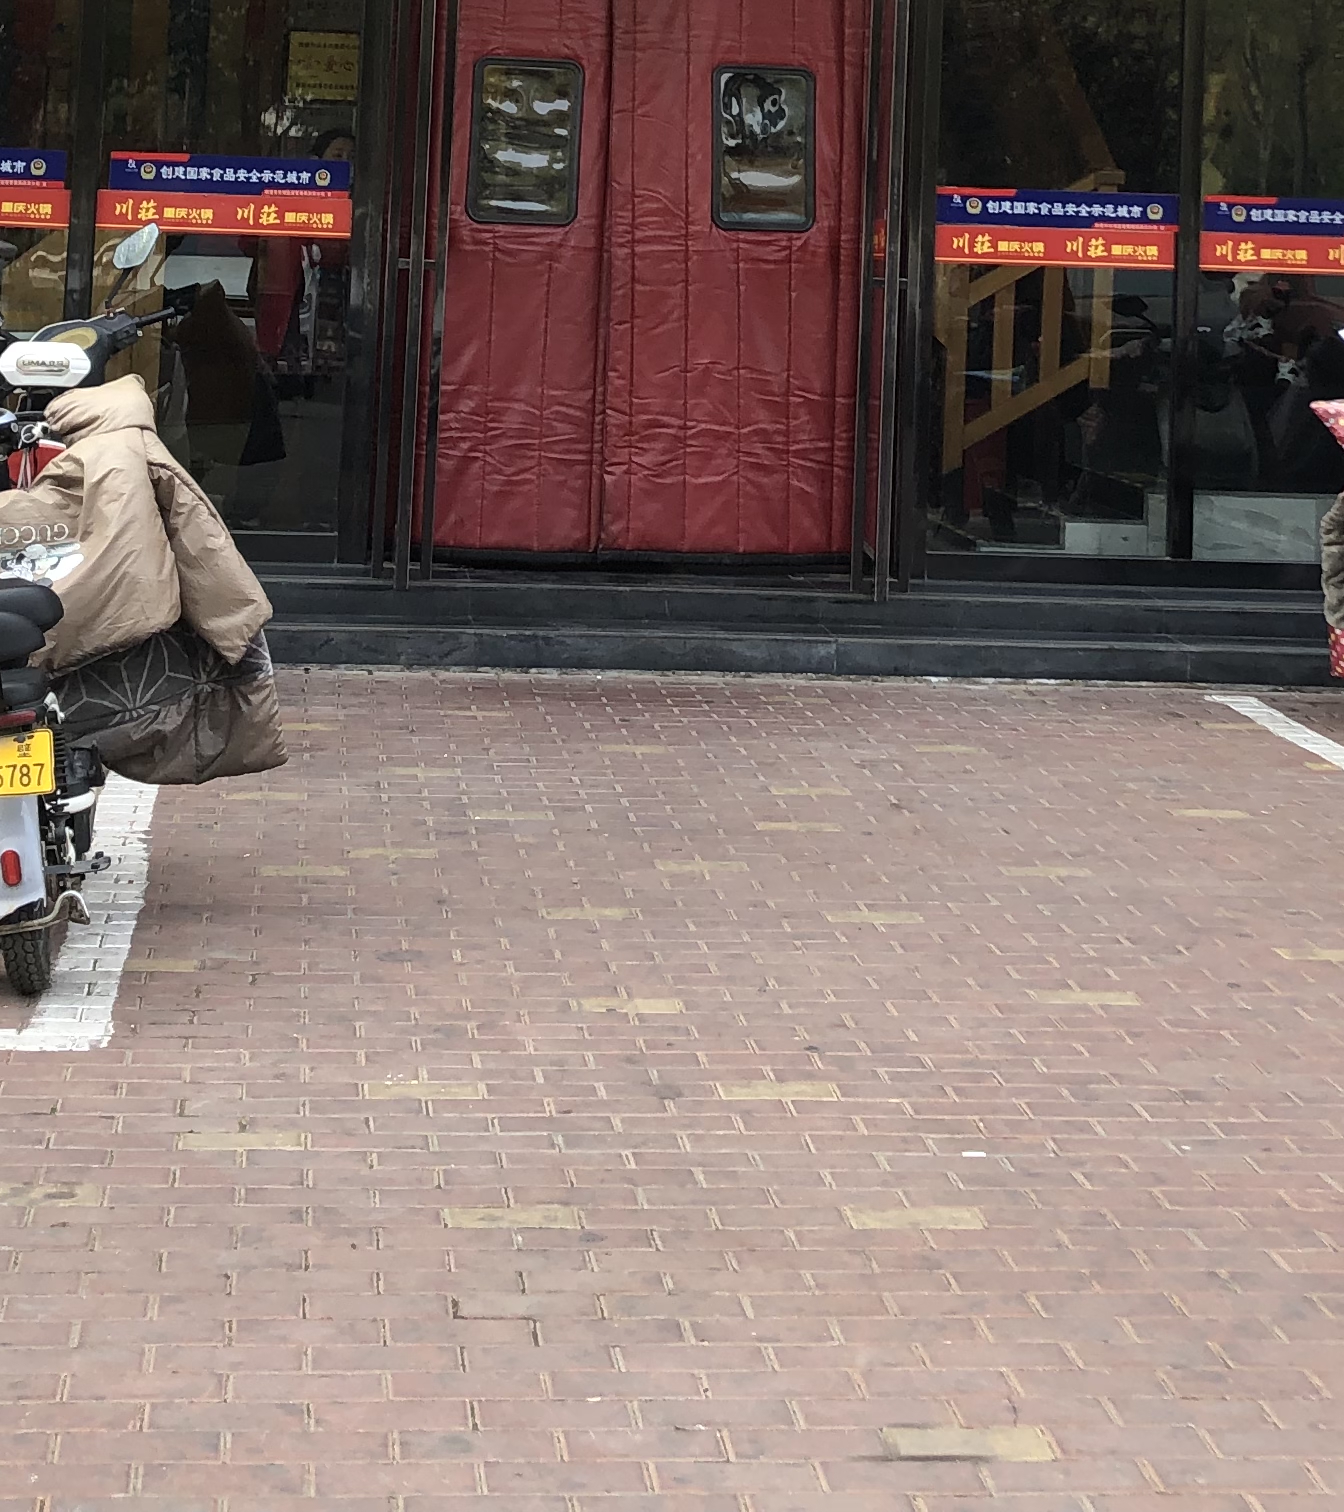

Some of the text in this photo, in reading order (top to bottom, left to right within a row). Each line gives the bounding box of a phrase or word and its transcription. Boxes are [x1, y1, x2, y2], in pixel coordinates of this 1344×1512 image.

[160, 165, 311, 184] 创建国家食品安全示范城市
[1, 202, 52, 215] 重庆火锅
[163, 207, 213, 220] 重庆火锅
[284, 212, 333, 224] 重庆火锅
[986, 200, 1143, 218] 创建国家食品安全示范城市
[998, 241, 1044, 253] 重庆火锅
[1111, 245, 1158, 256] 重庆火锅
